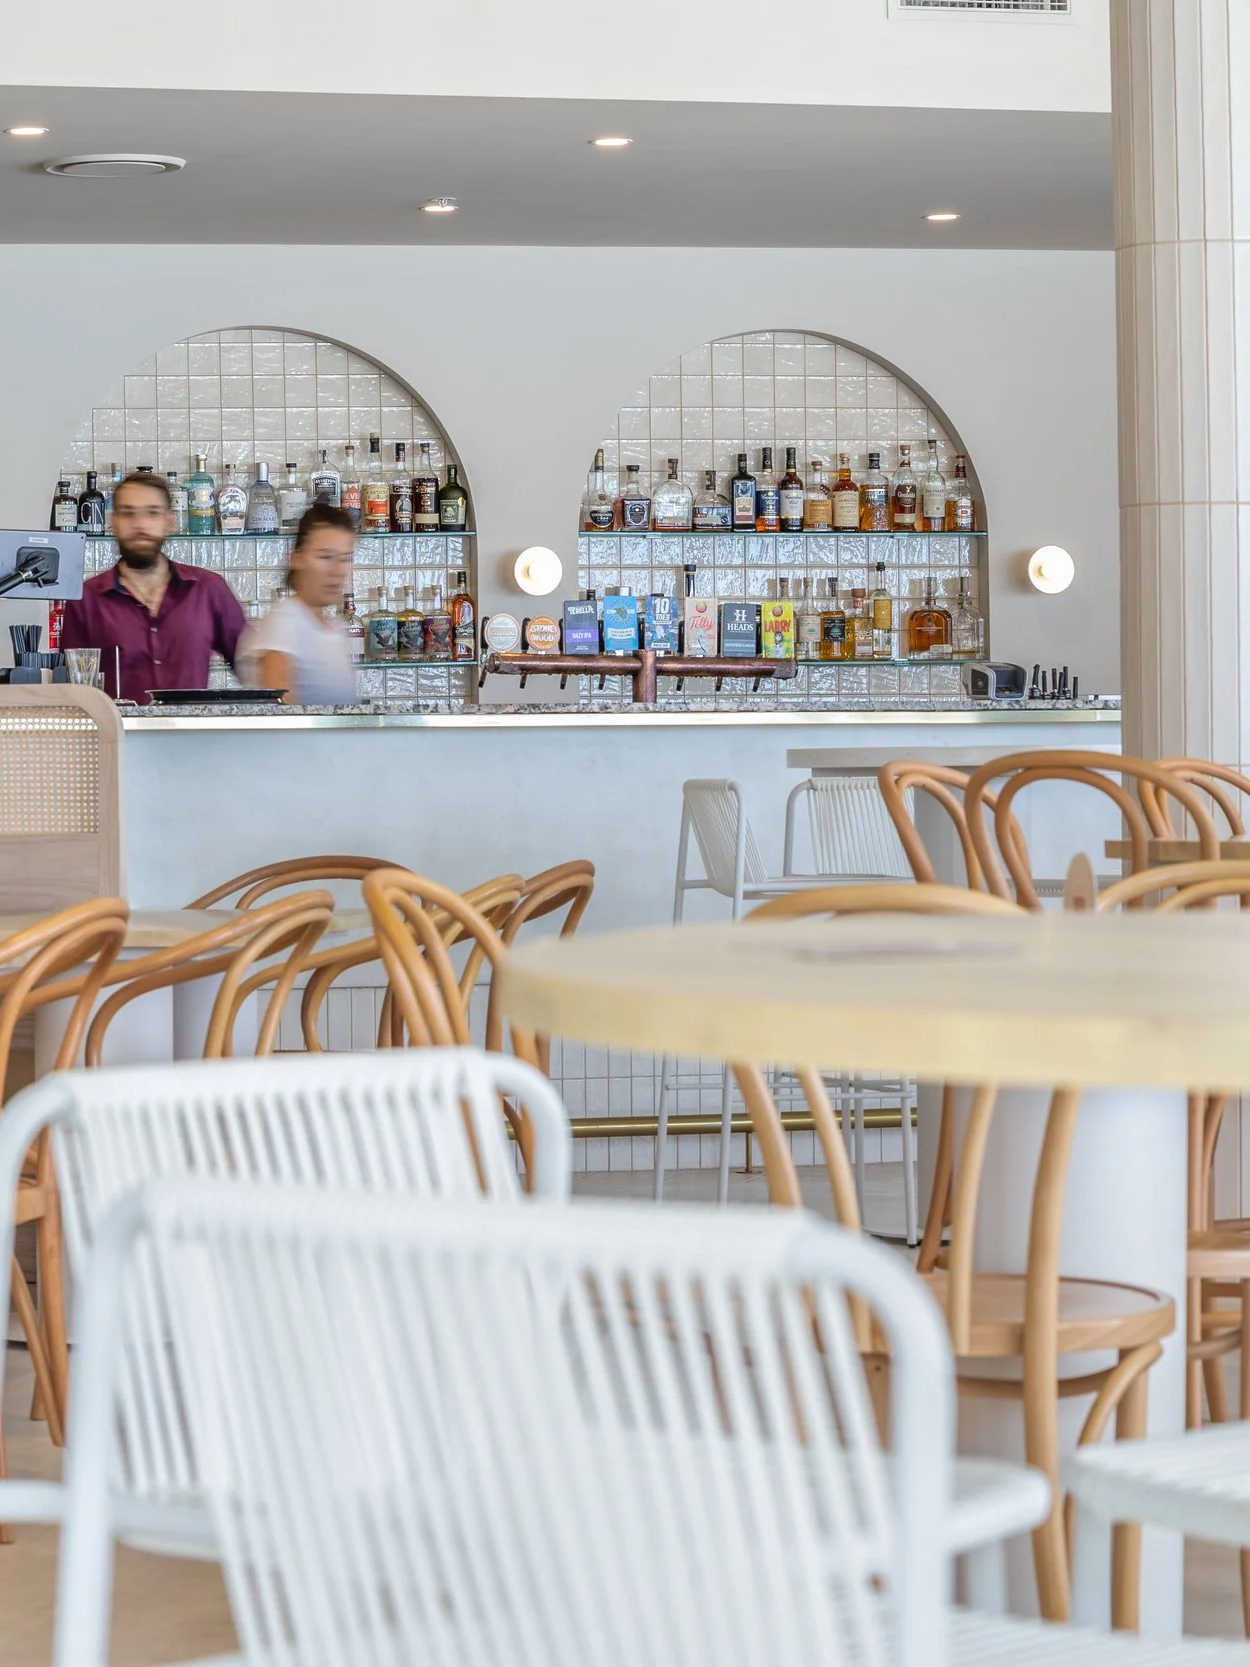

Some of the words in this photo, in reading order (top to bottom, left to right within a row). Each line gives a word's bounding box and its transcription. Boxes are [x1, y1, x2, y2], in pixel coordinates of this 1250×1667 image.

[80, 502, 105, 525] GIN
[654, 598, 670, 614] 10
[727, 623, 754, 631] HEADS
[764, 620, 791, 632] LARRY
